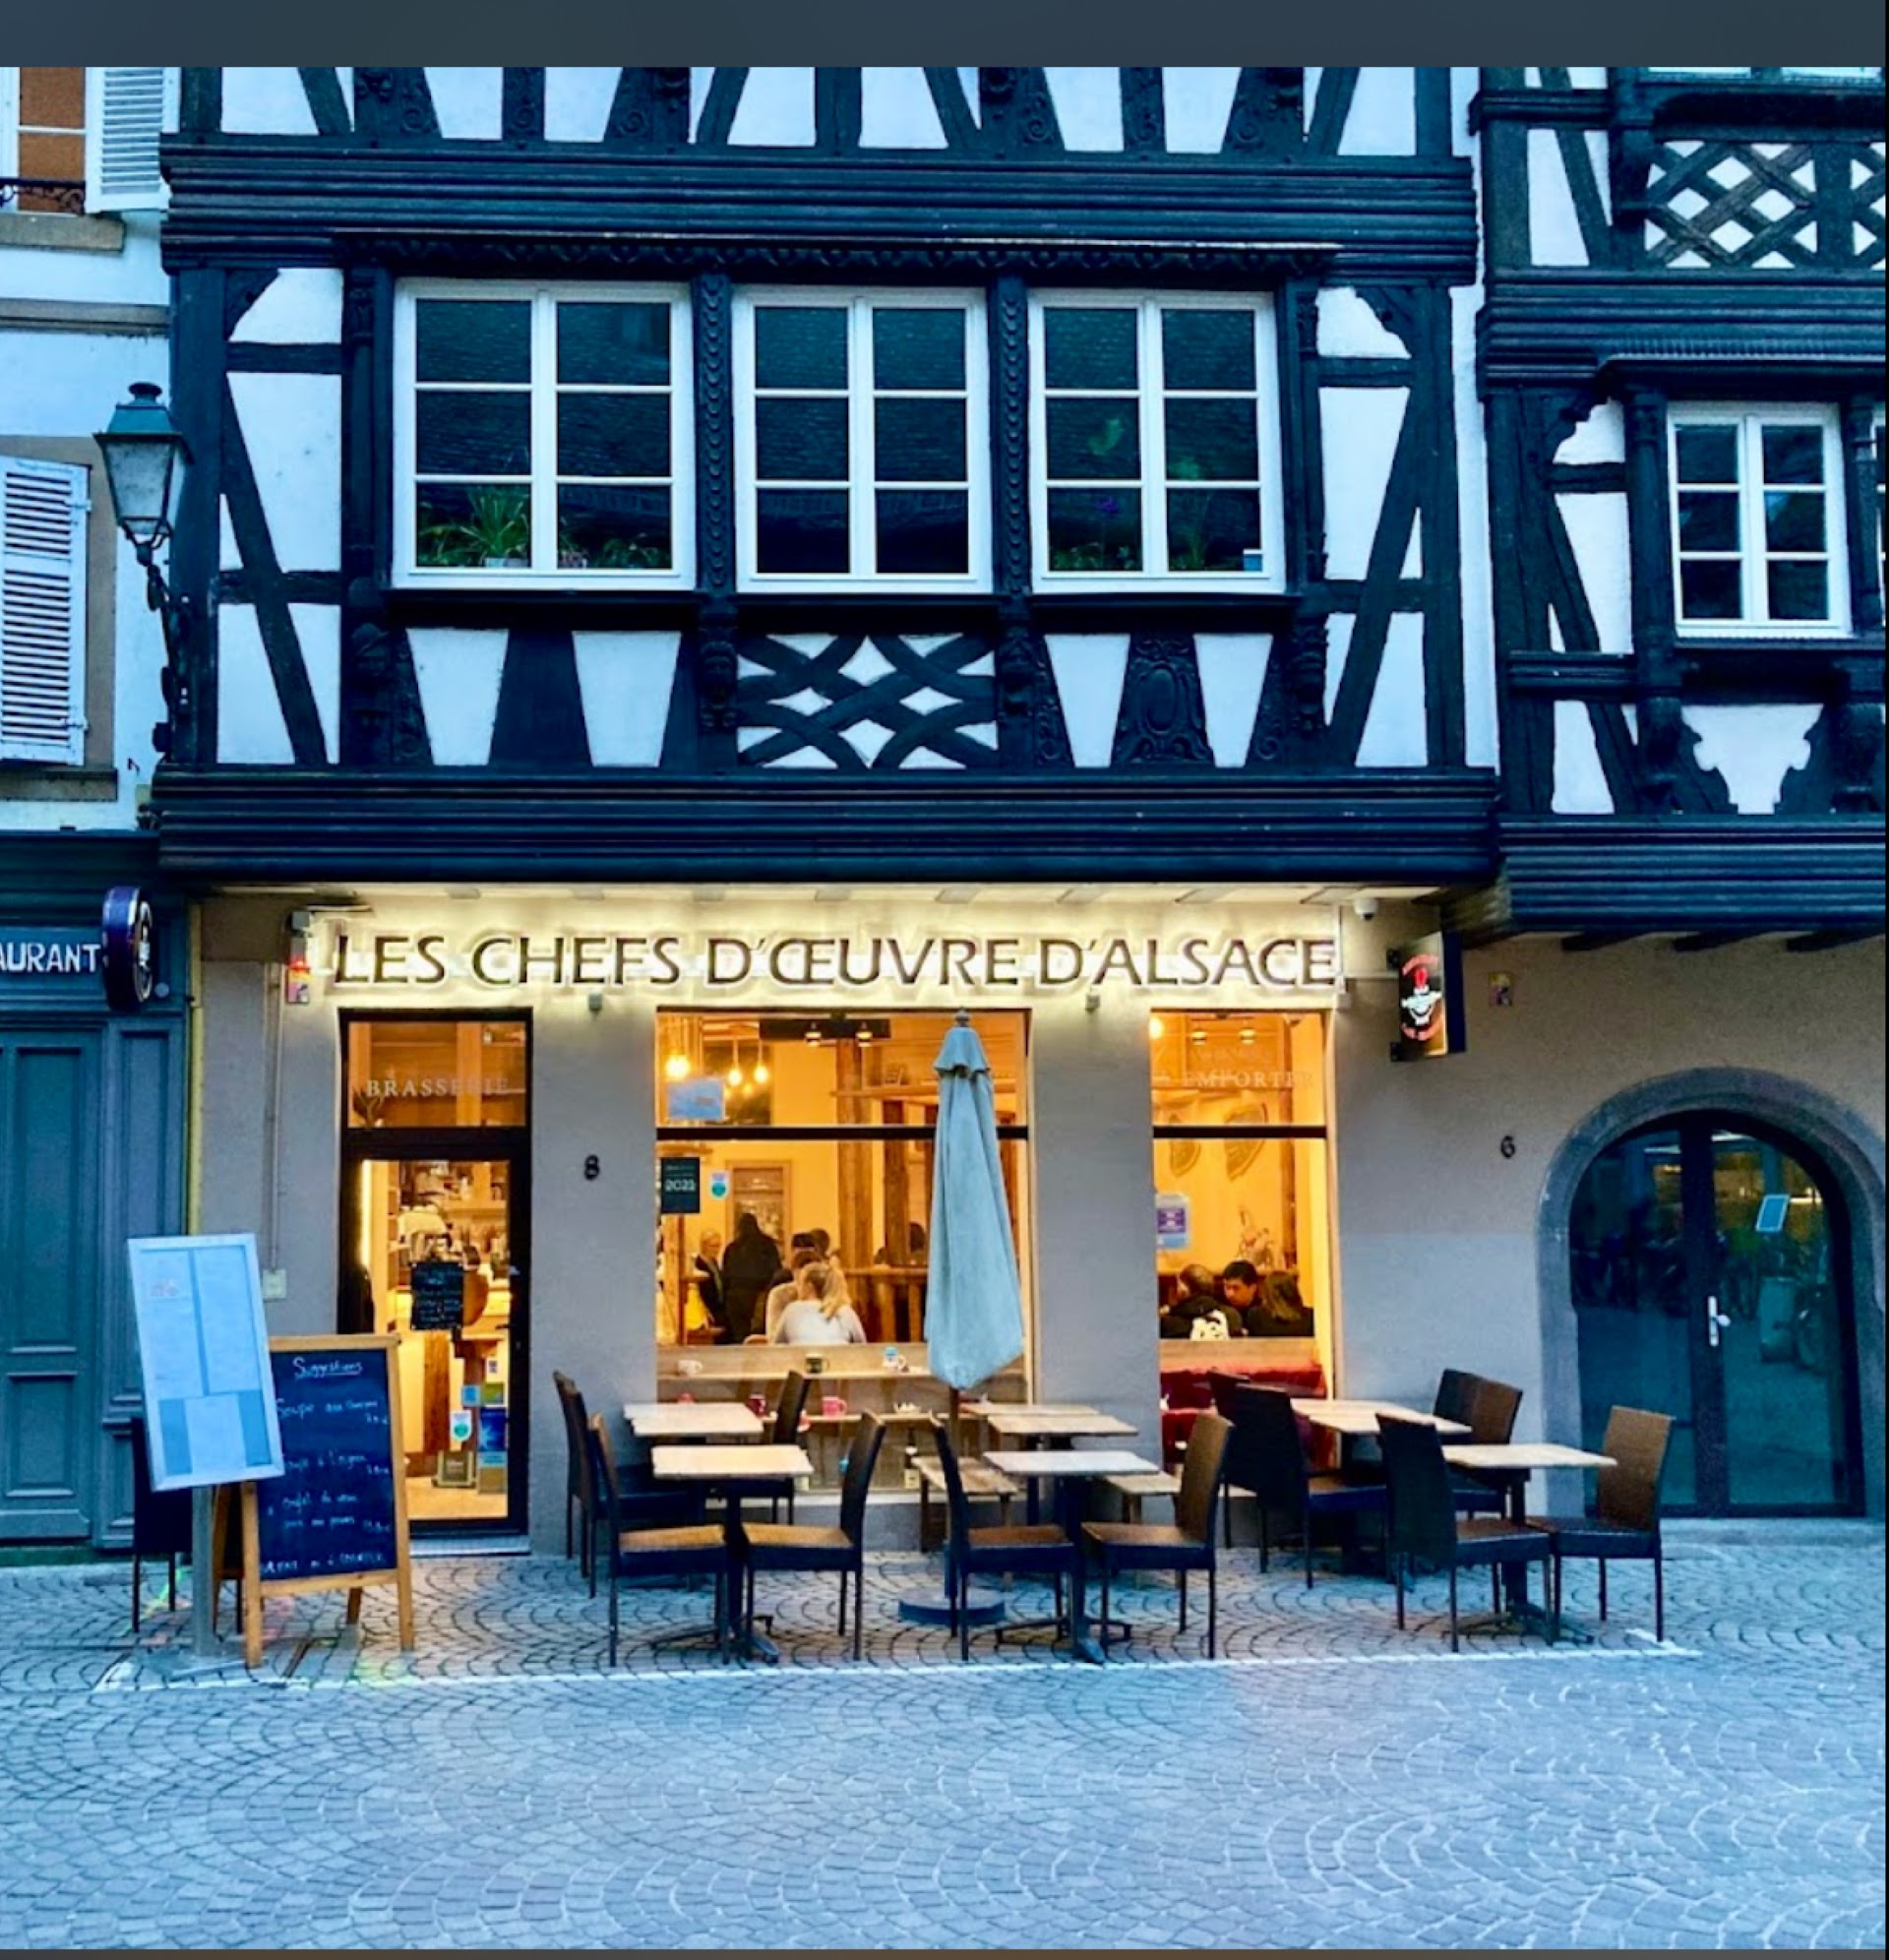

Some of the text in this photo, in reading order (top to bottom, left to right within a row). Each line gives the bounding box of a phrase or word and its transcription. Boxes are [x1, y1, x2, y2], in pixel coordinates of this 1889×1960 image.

[334, 935, 445, 984] LES
[472, 936, 680, 984] CHEFS
[1039, 939, 1335, 985] D'ALSACE
[1500, 1135, 1515, 1159] 6
[584, 1154, 600, 1181] 8
